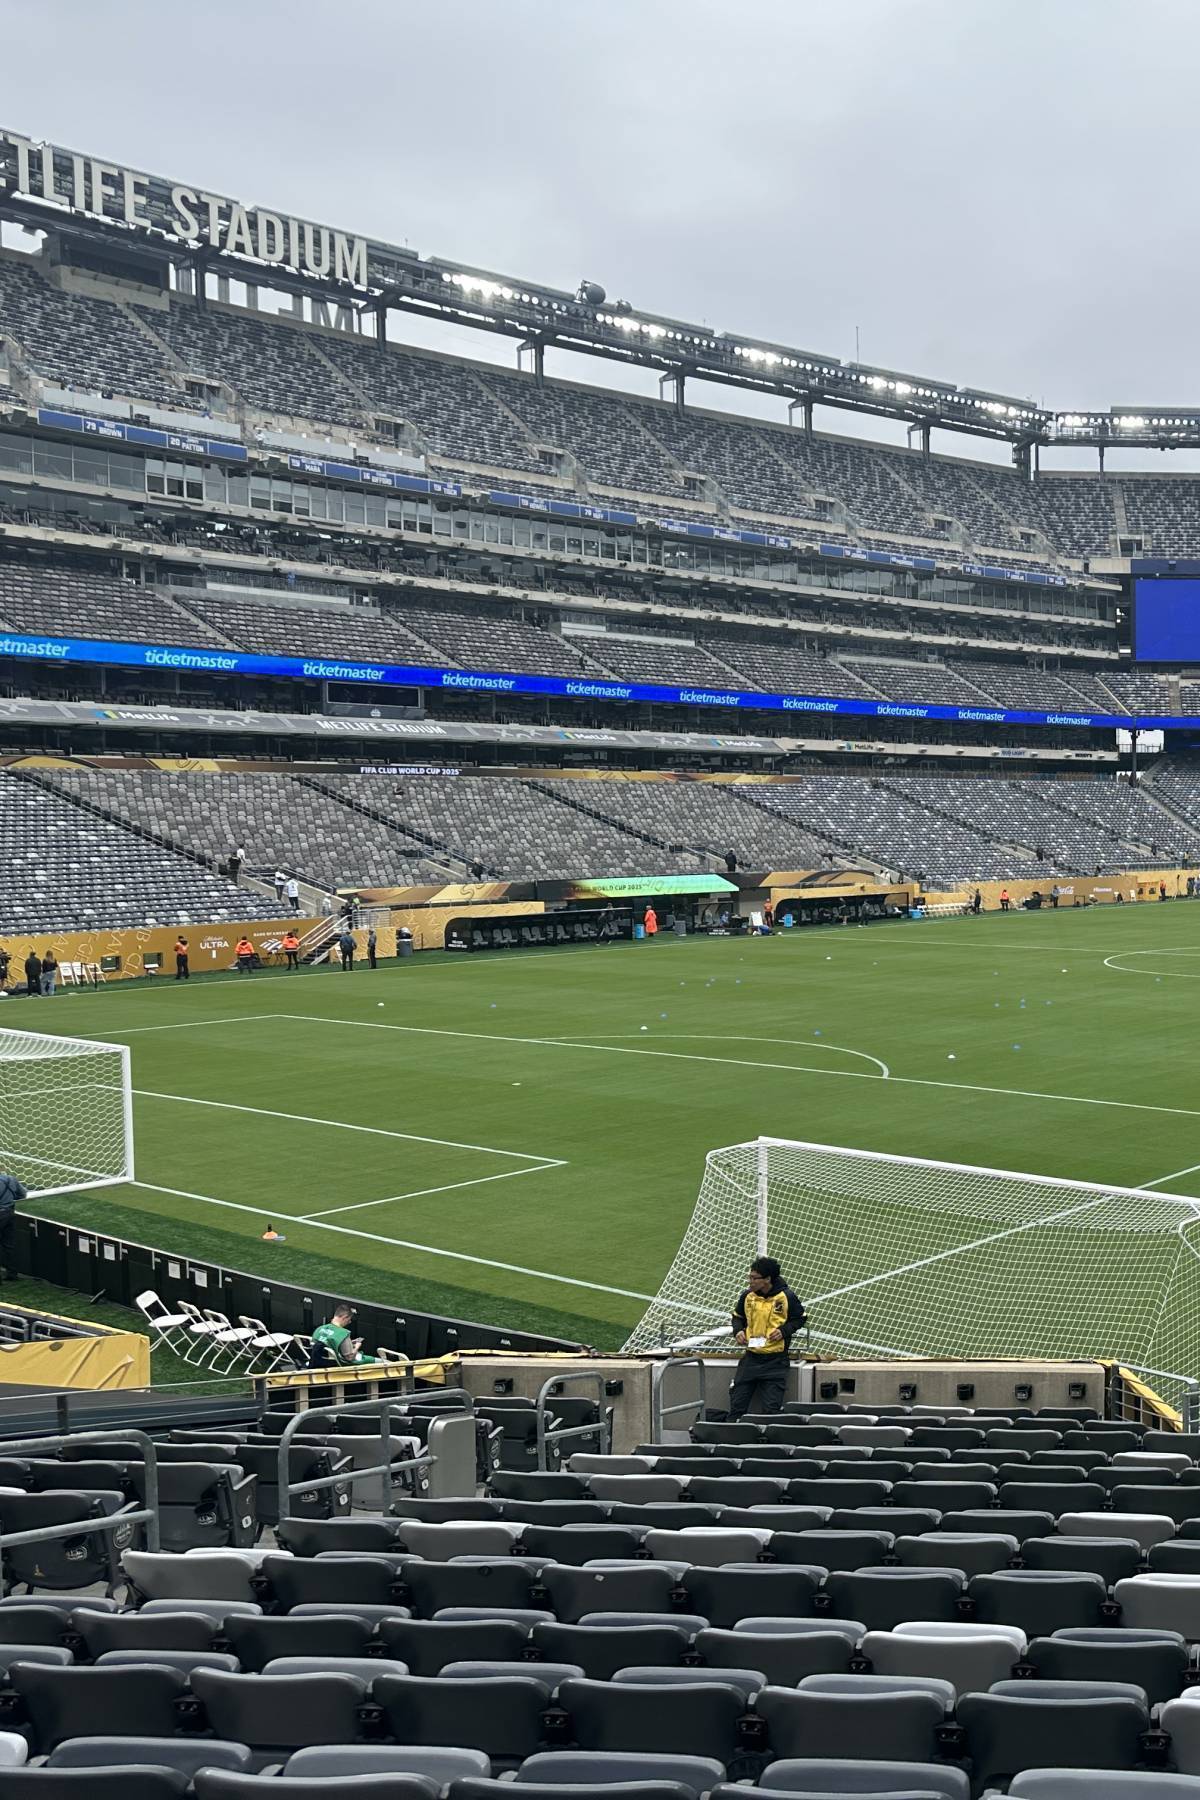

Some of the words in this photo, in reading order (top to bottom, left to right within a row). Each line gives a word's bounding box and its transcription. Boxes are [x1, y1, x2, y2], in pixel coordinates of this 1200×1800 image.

[0, 133, 152, 228] TLIFE
[171, 186, 368, 289] STADIUM
[144, 650, 238, 669] ticketmaster
[303, 662, 385, 680] ticketmaster
[442, 673, 515, 690] ticketmaster
[566, 682, 632, 698] ticketmaster
[679, 691, 740, 705] ticketmaster
[782, 698, 838, 712] ticketmaster
[119, 711, 180, 721] MetLife
[877, 705, 928, 717] ticketmaster
[958, 710, 1006, 722] ticketmaster
[1046, 714, 1092, 726] ticketmaster
[317, 720, 382, 733] METLIFE
[382, 722, 447, 735] STADIUM
[360, 766, 377, 774] FIFA
[398, 767, 424, 775] WORLD
[200, 940, 229, 949] ULTRA
